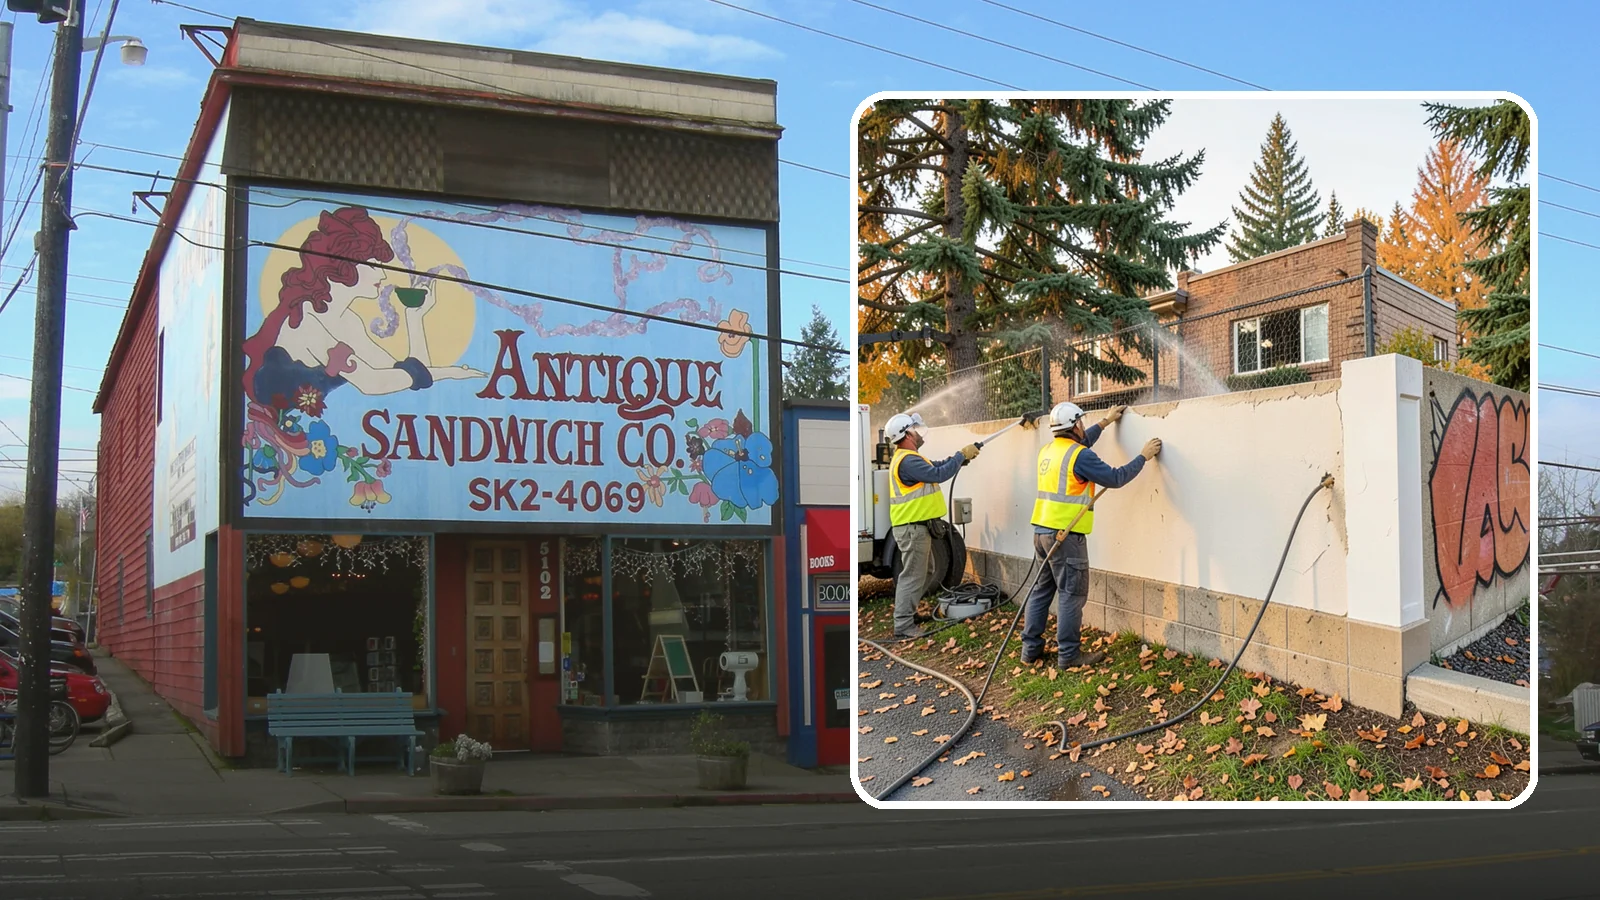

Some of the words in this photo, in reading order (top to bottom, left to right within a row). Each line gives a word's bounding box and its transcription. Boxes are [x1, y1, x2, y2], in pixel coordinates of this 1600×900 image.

[476, 329, 723, 420] ANTIQUE
[361, 408, 604, 467] SANDWICH
[617, 421, 685, 469] CO.
[468, 477, 646, 513] SK2-4069
[539, 541, 552, 600] 5102
[809, 555, 835, 569] BOOKS
